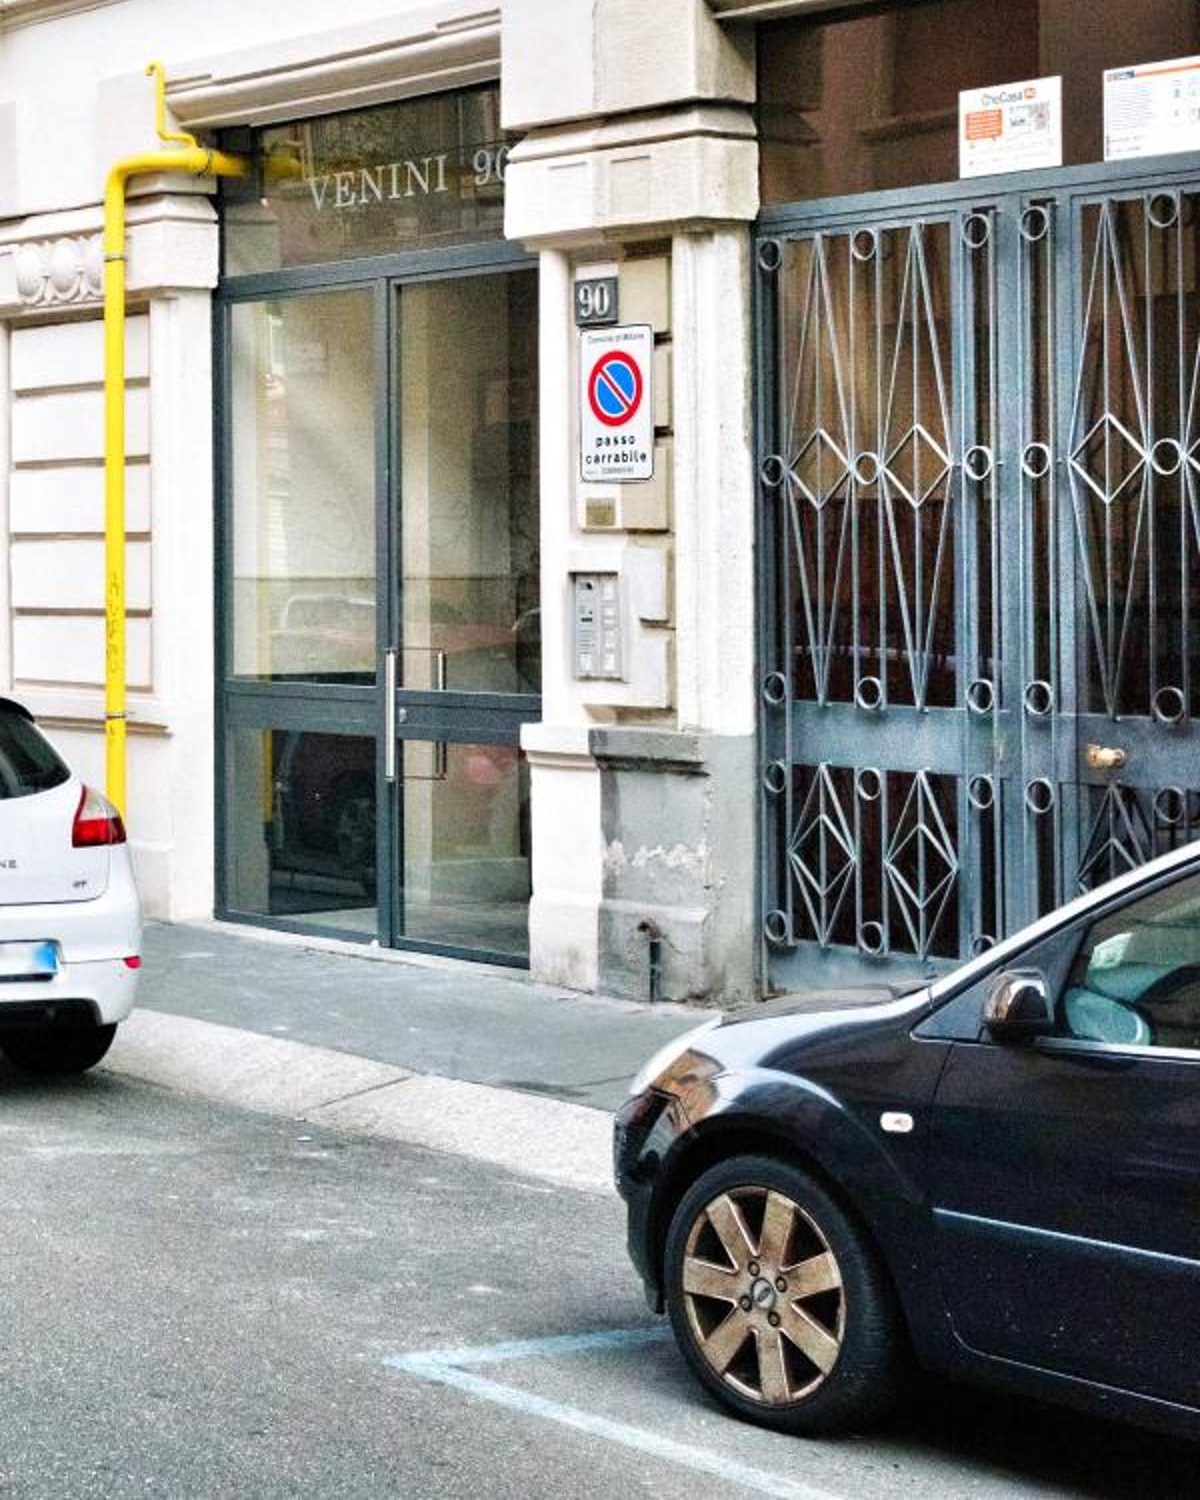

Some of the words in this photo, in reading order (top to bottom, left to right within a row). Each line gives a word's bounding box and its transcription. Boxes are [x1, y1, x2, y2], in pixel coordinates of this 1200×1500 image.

[305, 155, 449, 212] VENINI
[578, 283, 610, 317] 90
[595, 435, 636, 448] passo
[585, 450, 647, 465] carrabile
